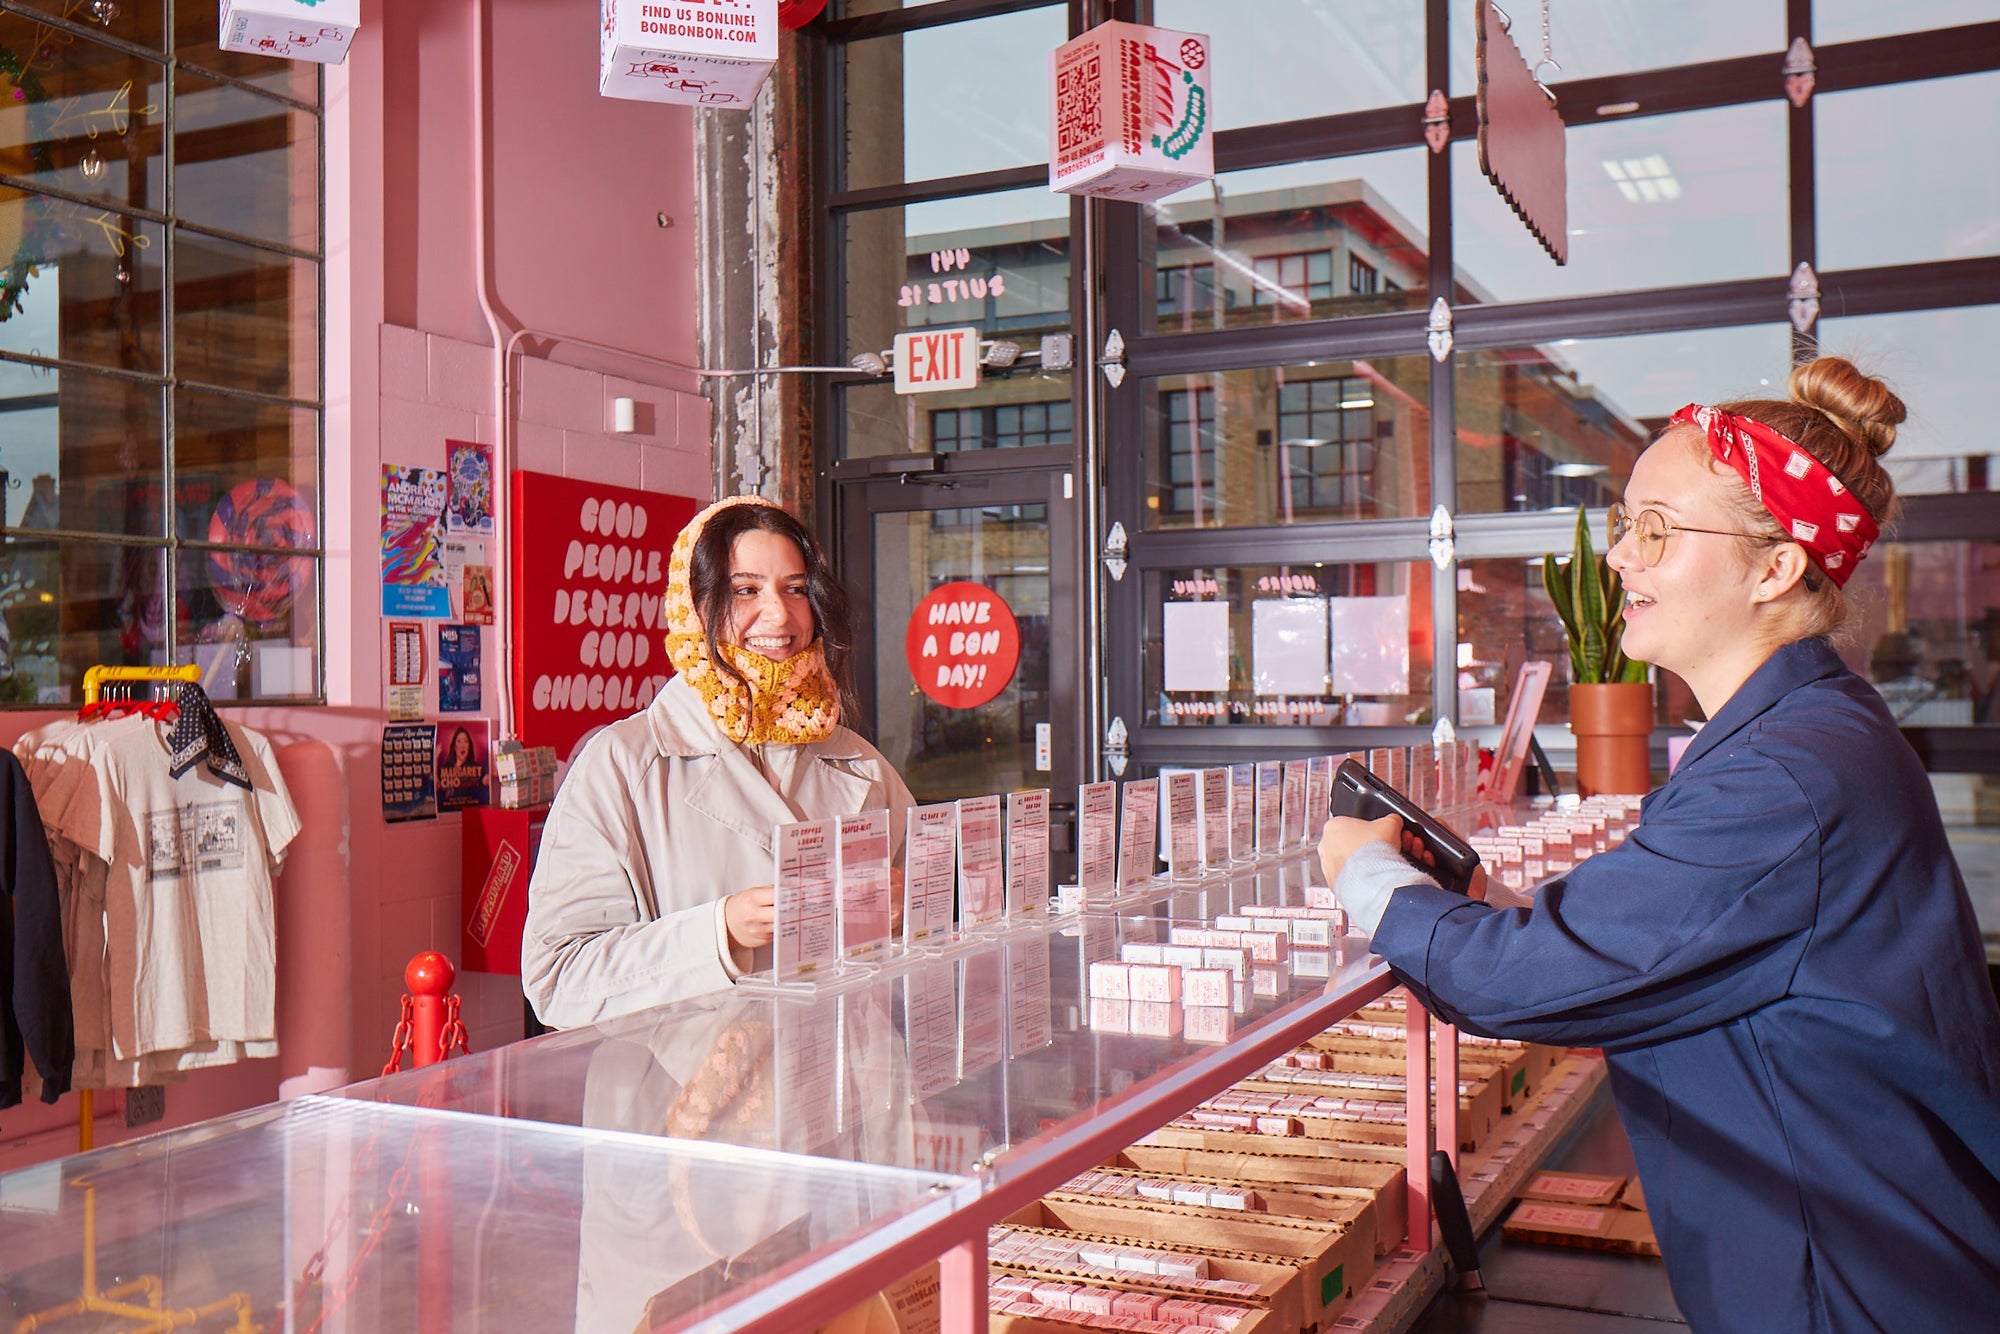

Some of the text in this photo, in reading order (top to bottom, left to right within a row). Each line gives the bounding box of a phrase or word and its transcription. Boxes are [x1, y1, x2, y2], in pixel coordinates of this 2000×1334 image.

[642, 5, 755, 27] FIND US BONLINE!
[641, 21, 757, 43] BONBONBON.COM
[1130, 40, 1142, 156] HAMTRAMCK
[1057, 152, 1105, 179] BONBONBON.COM
[1071, 150, 1078, 162] US
[908, 332, 964, 383] EXIT
[387, 493, 442, 508] MCMAHON
[388, 482, 433, 497] ANDREW
[580, 497, 648, 539] GOOD
[564, 539, 662, 584] PEOPLE
[928, 601, 991, 626] HAVE
[580, 631, 650, 668] GOOD
[922, 629, 1000, 657] A BON
[936, 663, 987, 689] DAY!
[440, 777, 460, 788] CHO
[441, 766, 482, 778] MARGARET
